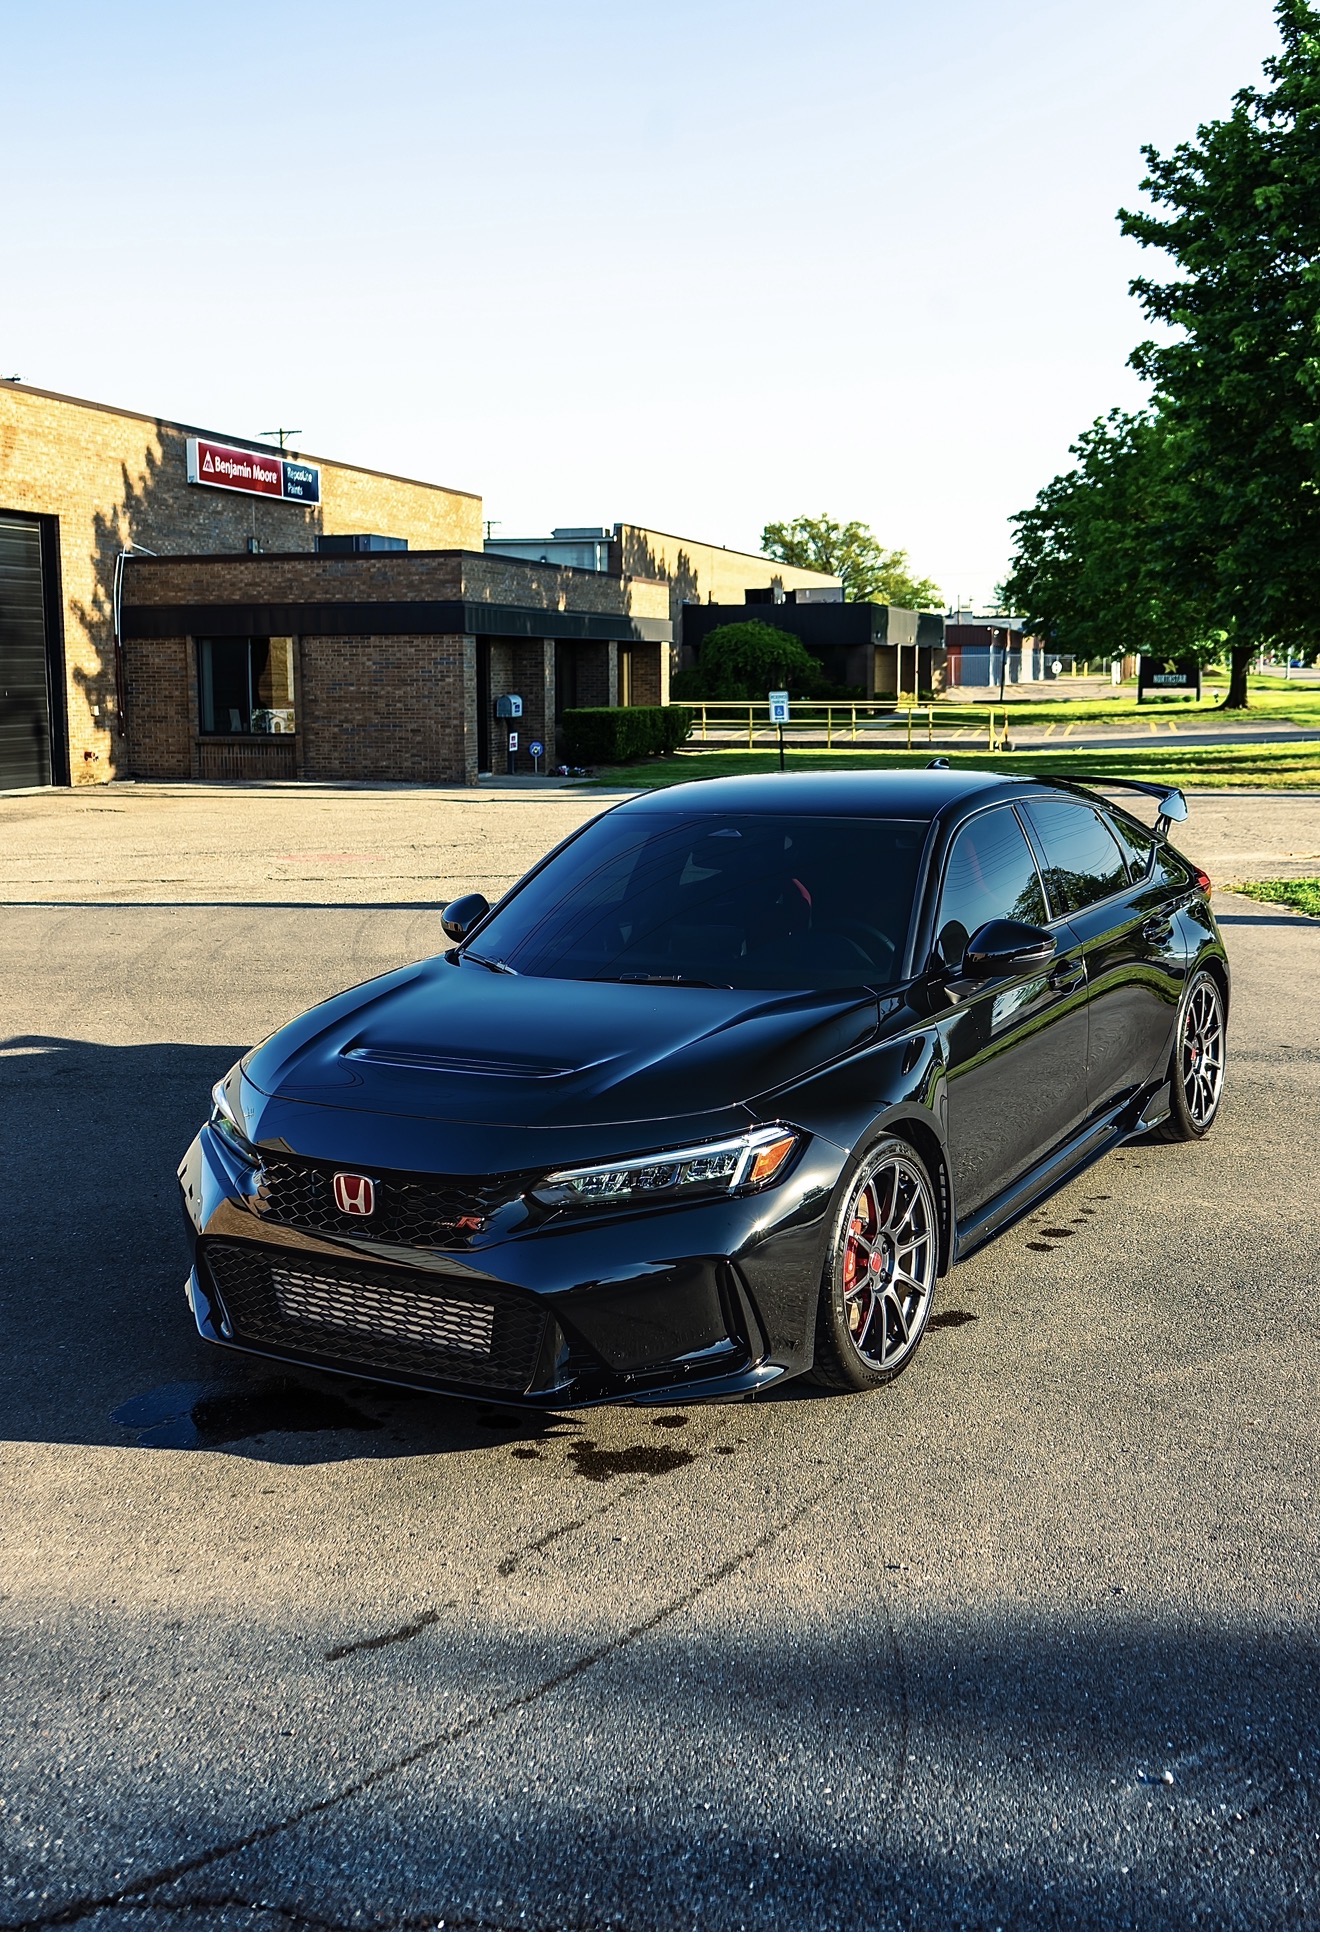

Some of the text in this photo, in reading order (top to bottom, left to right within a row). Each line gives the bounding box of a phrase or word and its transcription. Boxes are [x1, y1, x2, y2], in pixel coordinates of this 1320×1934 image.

[215, 456, 277, 484] Benjamin Moore
[1152, 674, 1187, 684] NORTHSTAR
